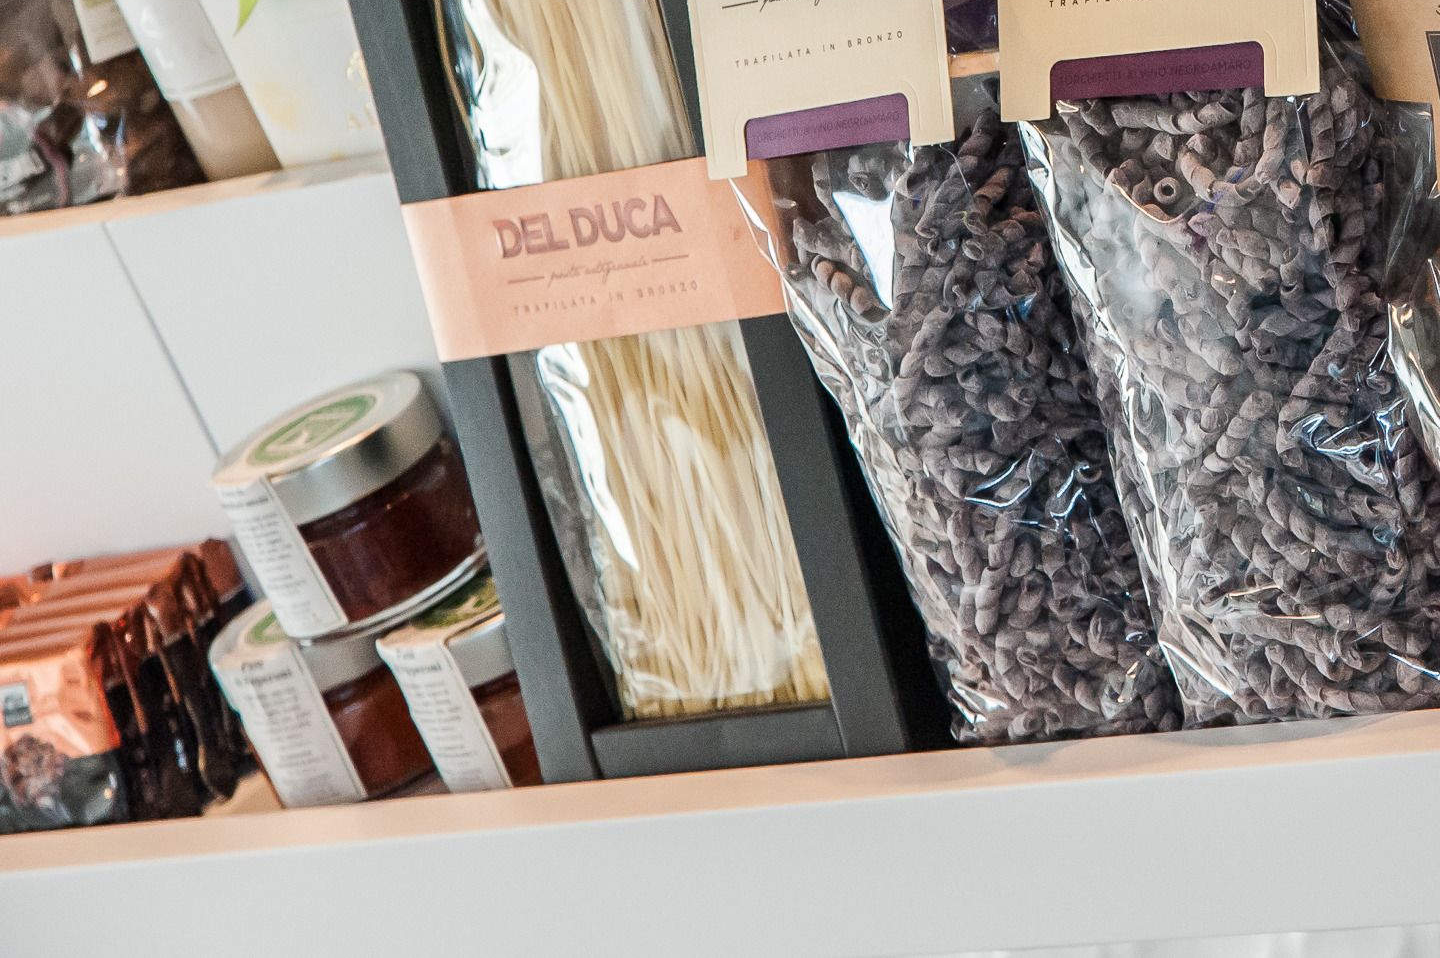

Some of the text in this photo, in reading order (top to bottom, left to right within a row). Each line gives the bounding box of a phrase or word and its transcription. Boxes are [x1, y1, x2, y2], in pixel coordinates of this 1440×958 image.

[736, 30, 903, 68] TRAFILATA IN BRONZO
[492, 194, 682, 258] DEL DUCA
[514, 280, 698, 314] TRAFILATA IN BRONZO
